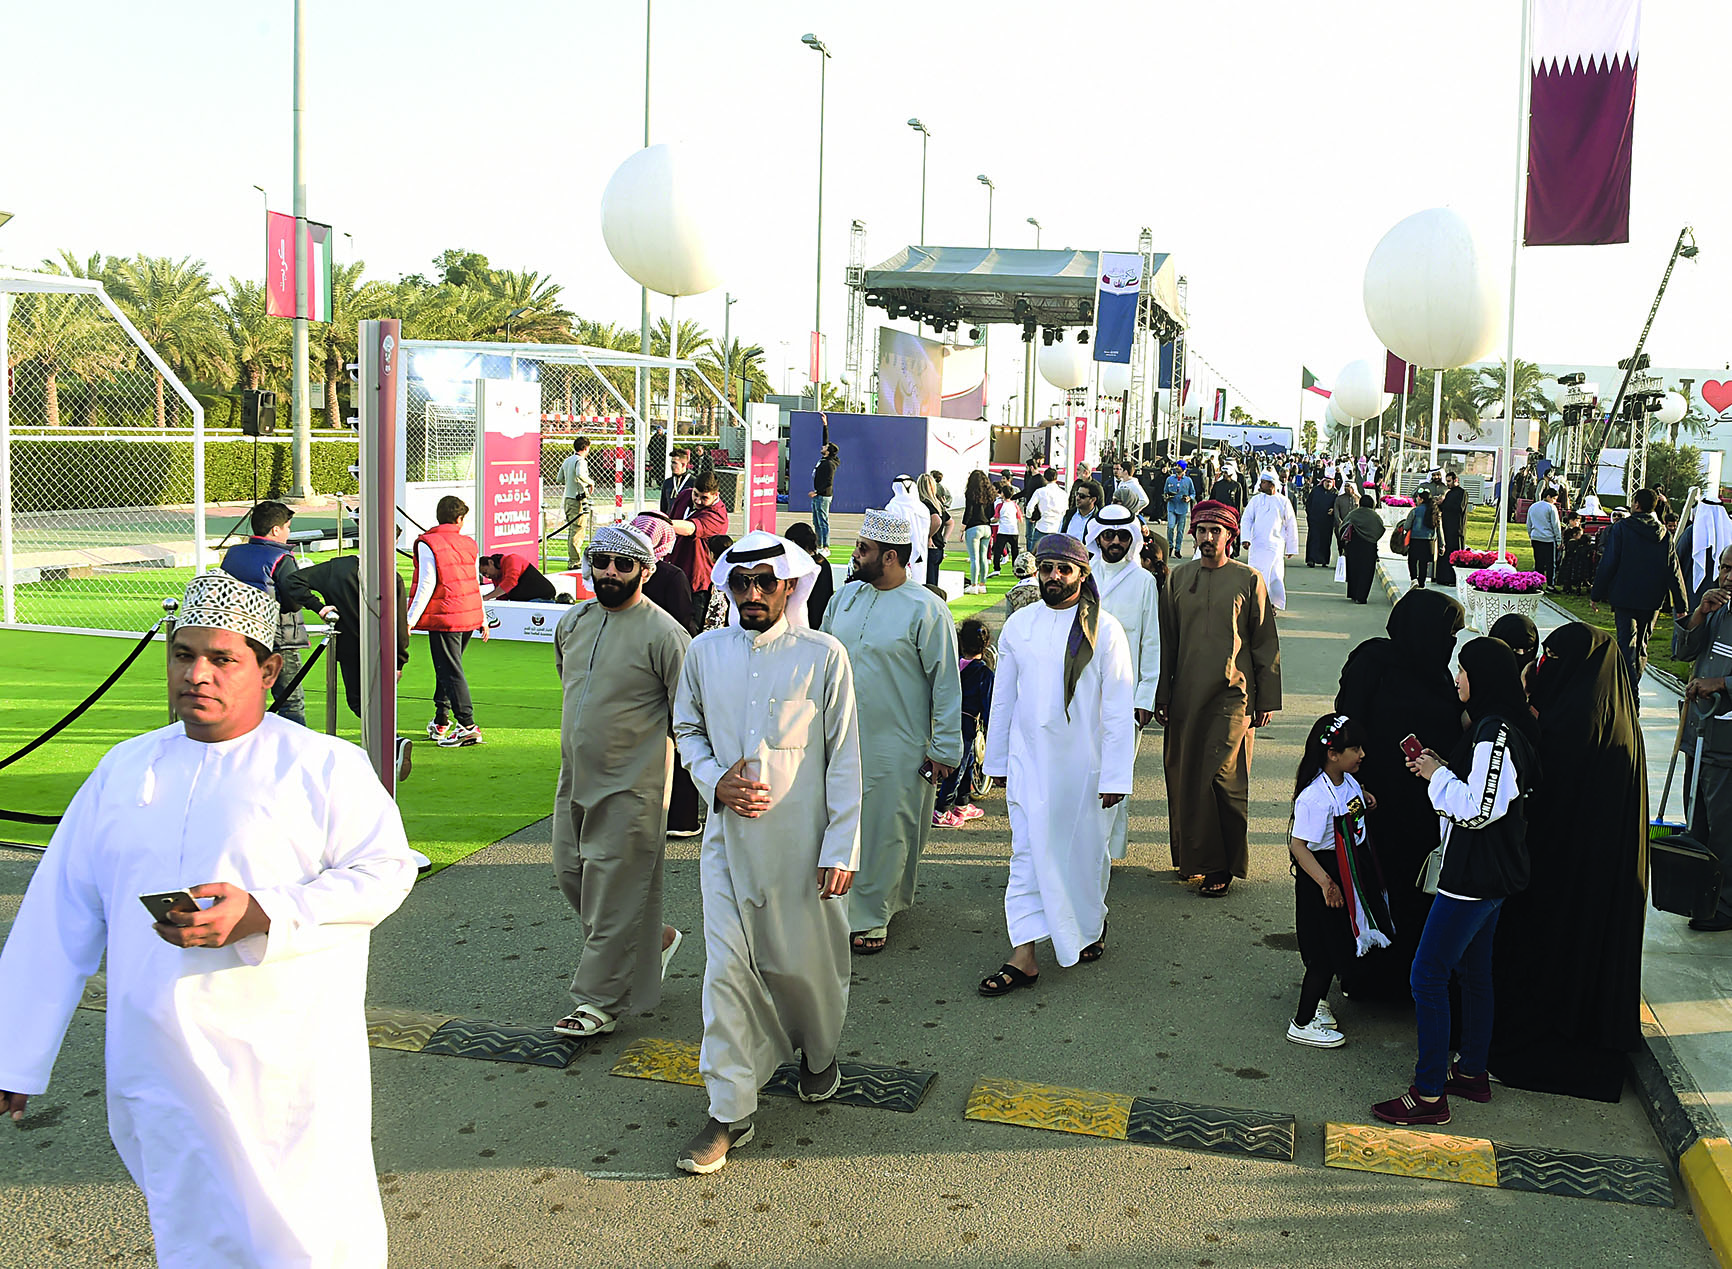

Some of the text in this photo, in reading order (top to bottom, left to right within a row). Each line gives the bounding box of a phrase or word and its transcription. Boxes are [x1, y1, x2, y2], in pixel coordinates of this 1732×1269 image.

[494, 489, 531, 506] كرة قدم
[494, 510, 531, 524] FOOTBALL
[494, 523, 530, 536] BILLIARDS
[1491, 750, 1503, 771] PINK
[1486, 773, 1498, 795] PINK
[1482, 797, 1493, 818] PINK
